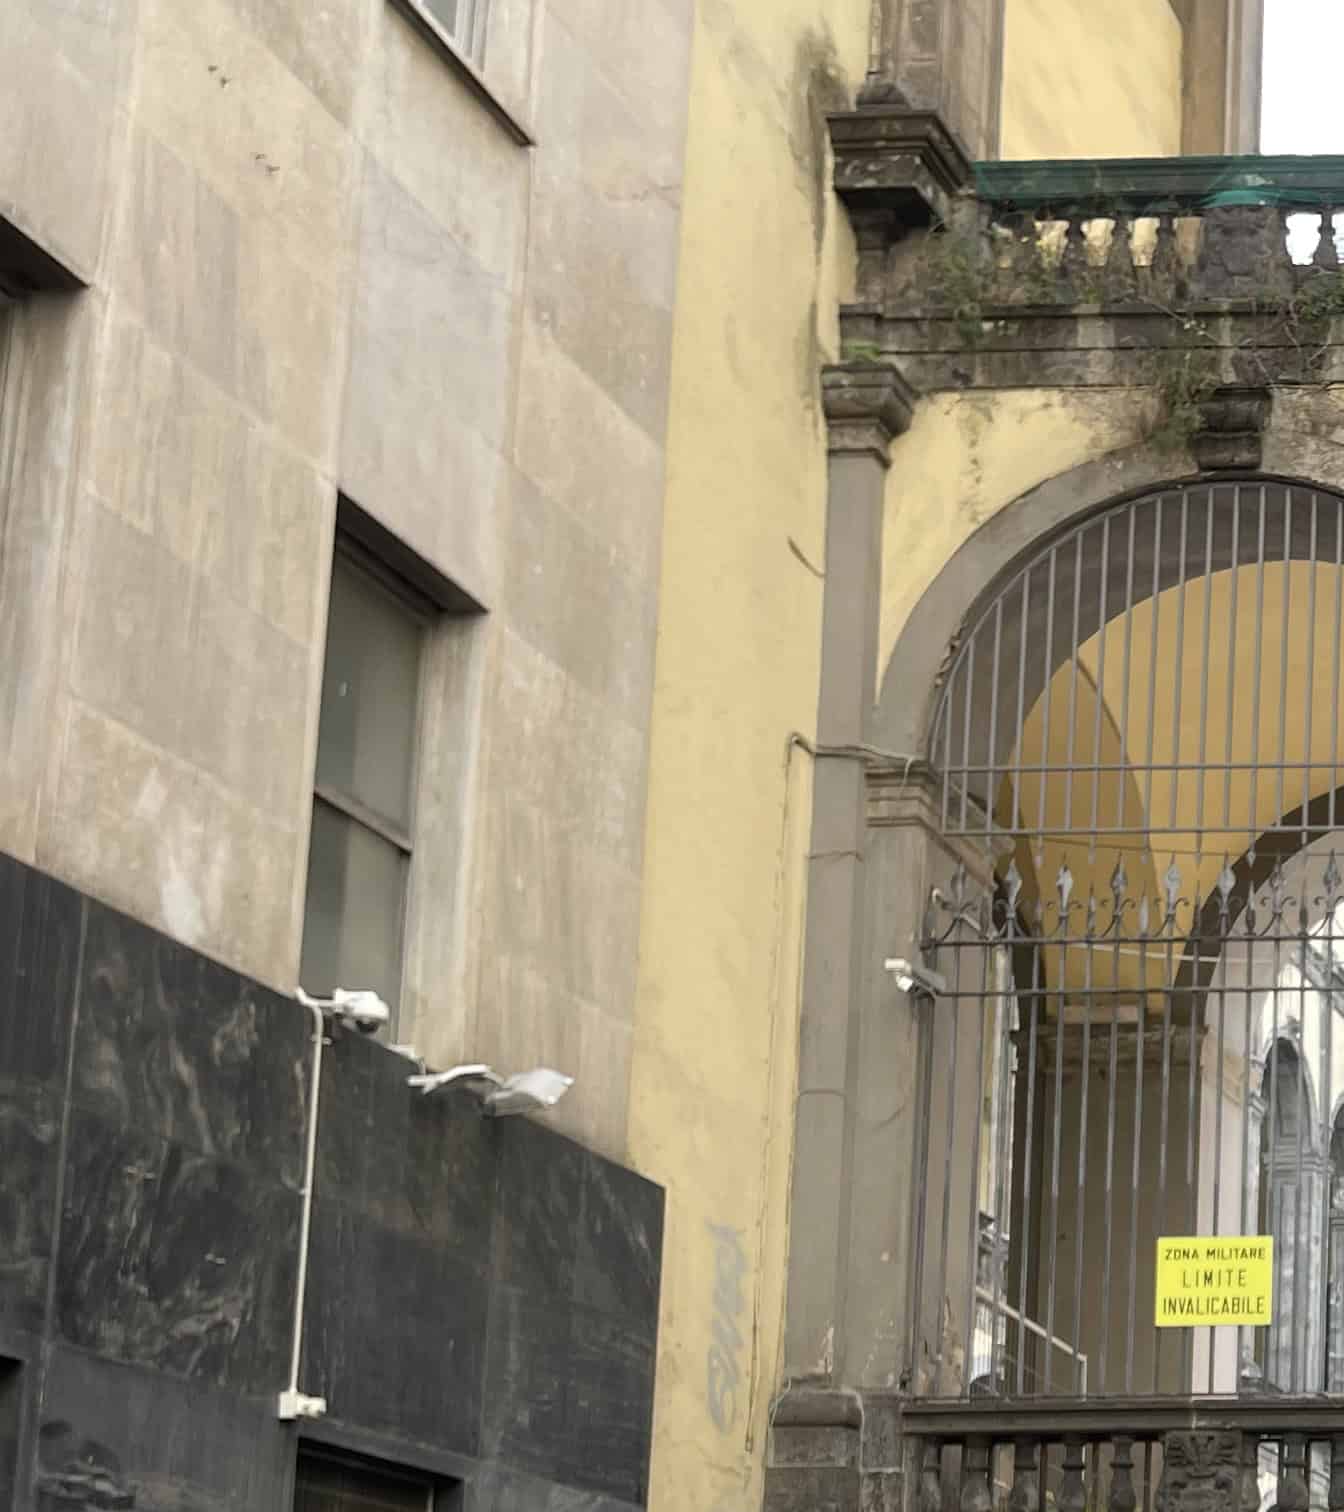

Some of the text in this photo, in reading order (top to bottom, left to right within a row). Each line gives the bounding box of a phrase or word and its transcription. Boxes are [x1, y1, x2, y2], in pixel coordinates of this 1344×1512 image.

[1164, 1246, 1266, 1260] ZONA MILITARE
[1182, 1268, 1247, 1289] LIMITE
[1163, 1296, 1265, 1316] INVALICABILE
